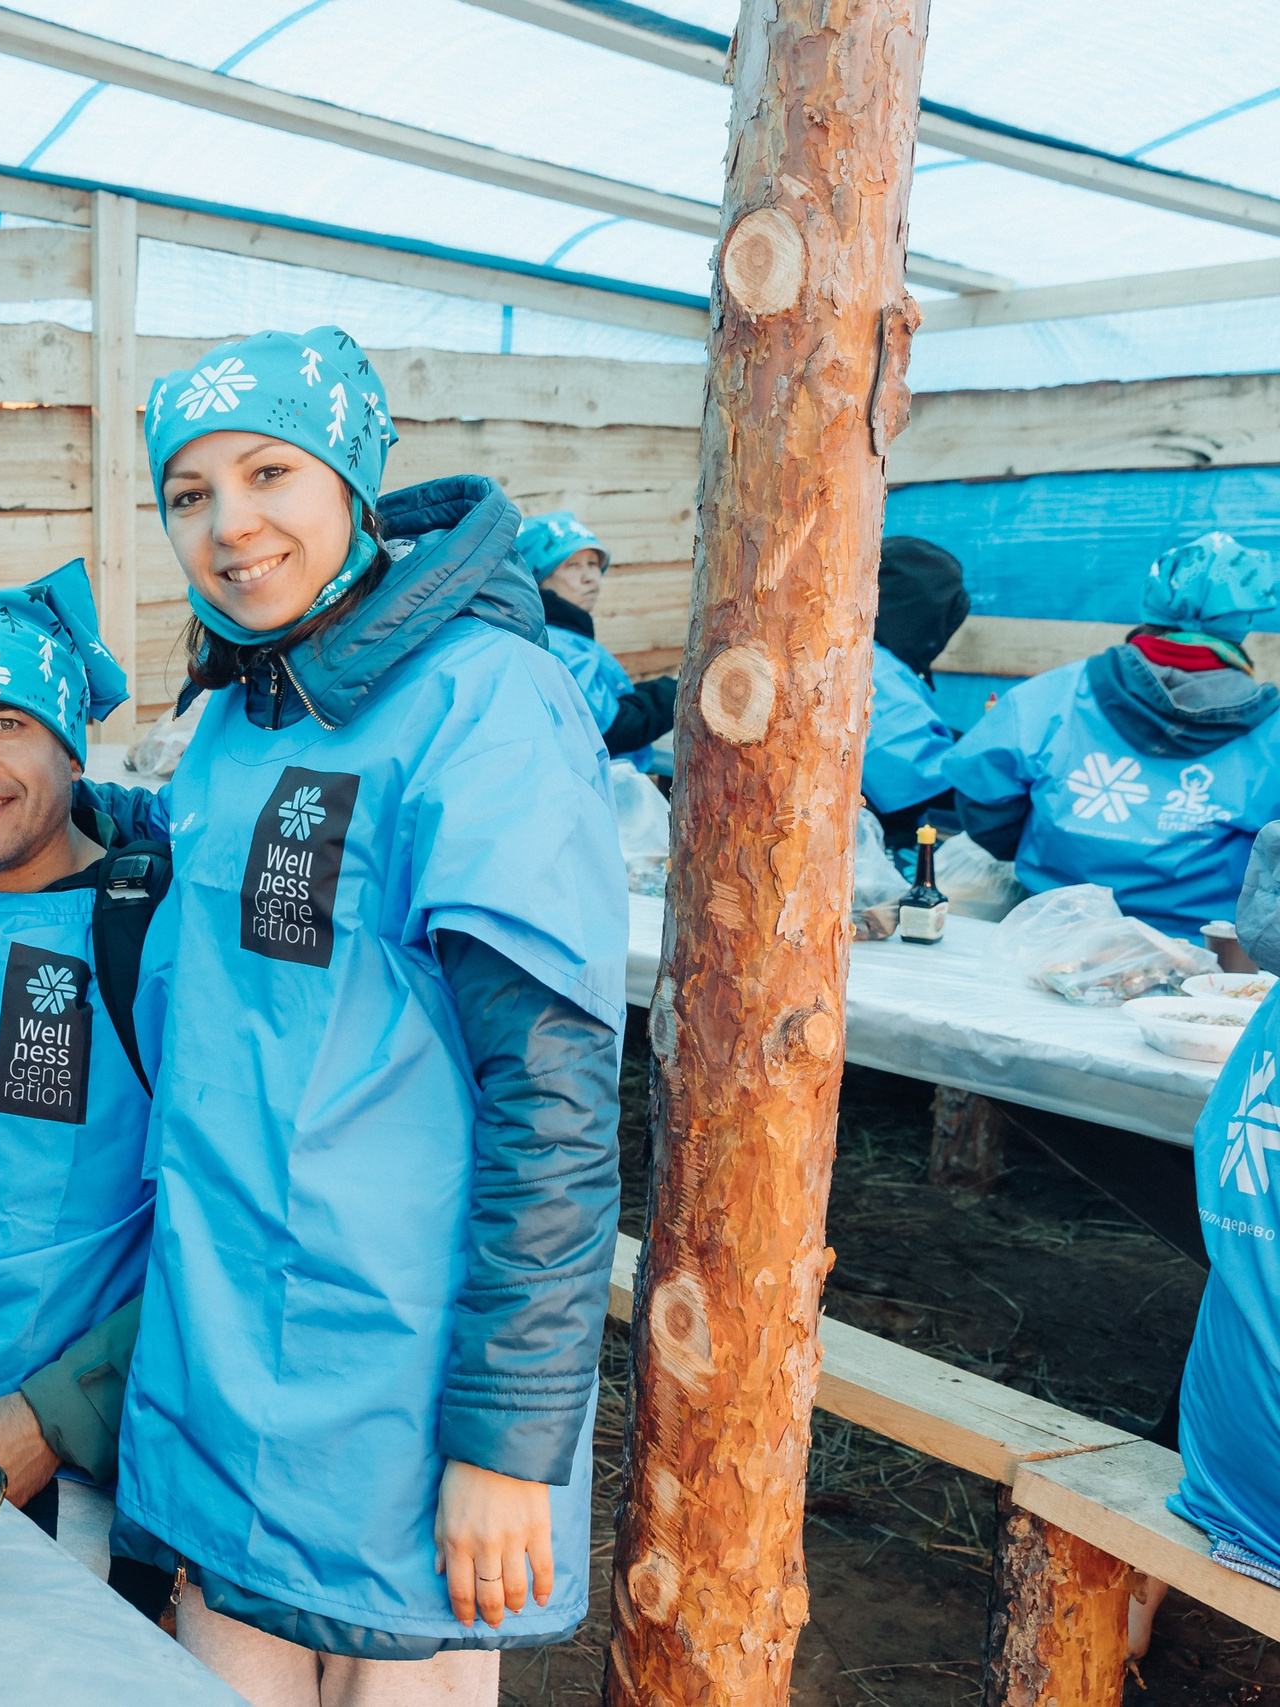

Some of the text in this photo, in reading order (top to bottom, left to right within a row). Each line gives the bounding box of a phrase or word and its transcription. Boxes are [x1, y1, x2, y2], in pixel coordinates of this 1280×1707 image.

[266, 843, 313, 879] Well
[260, 871, 309, 901] ness
[254, 888, 313, 924] Gene
[252, 915, 317, 947] ration
[19, 1016, 71, 1047] Well
[14, 1042, 70, 1066] ness
[9, 1056, 71, 1087] Gene
[4, 1081, 72, 1107] ration
